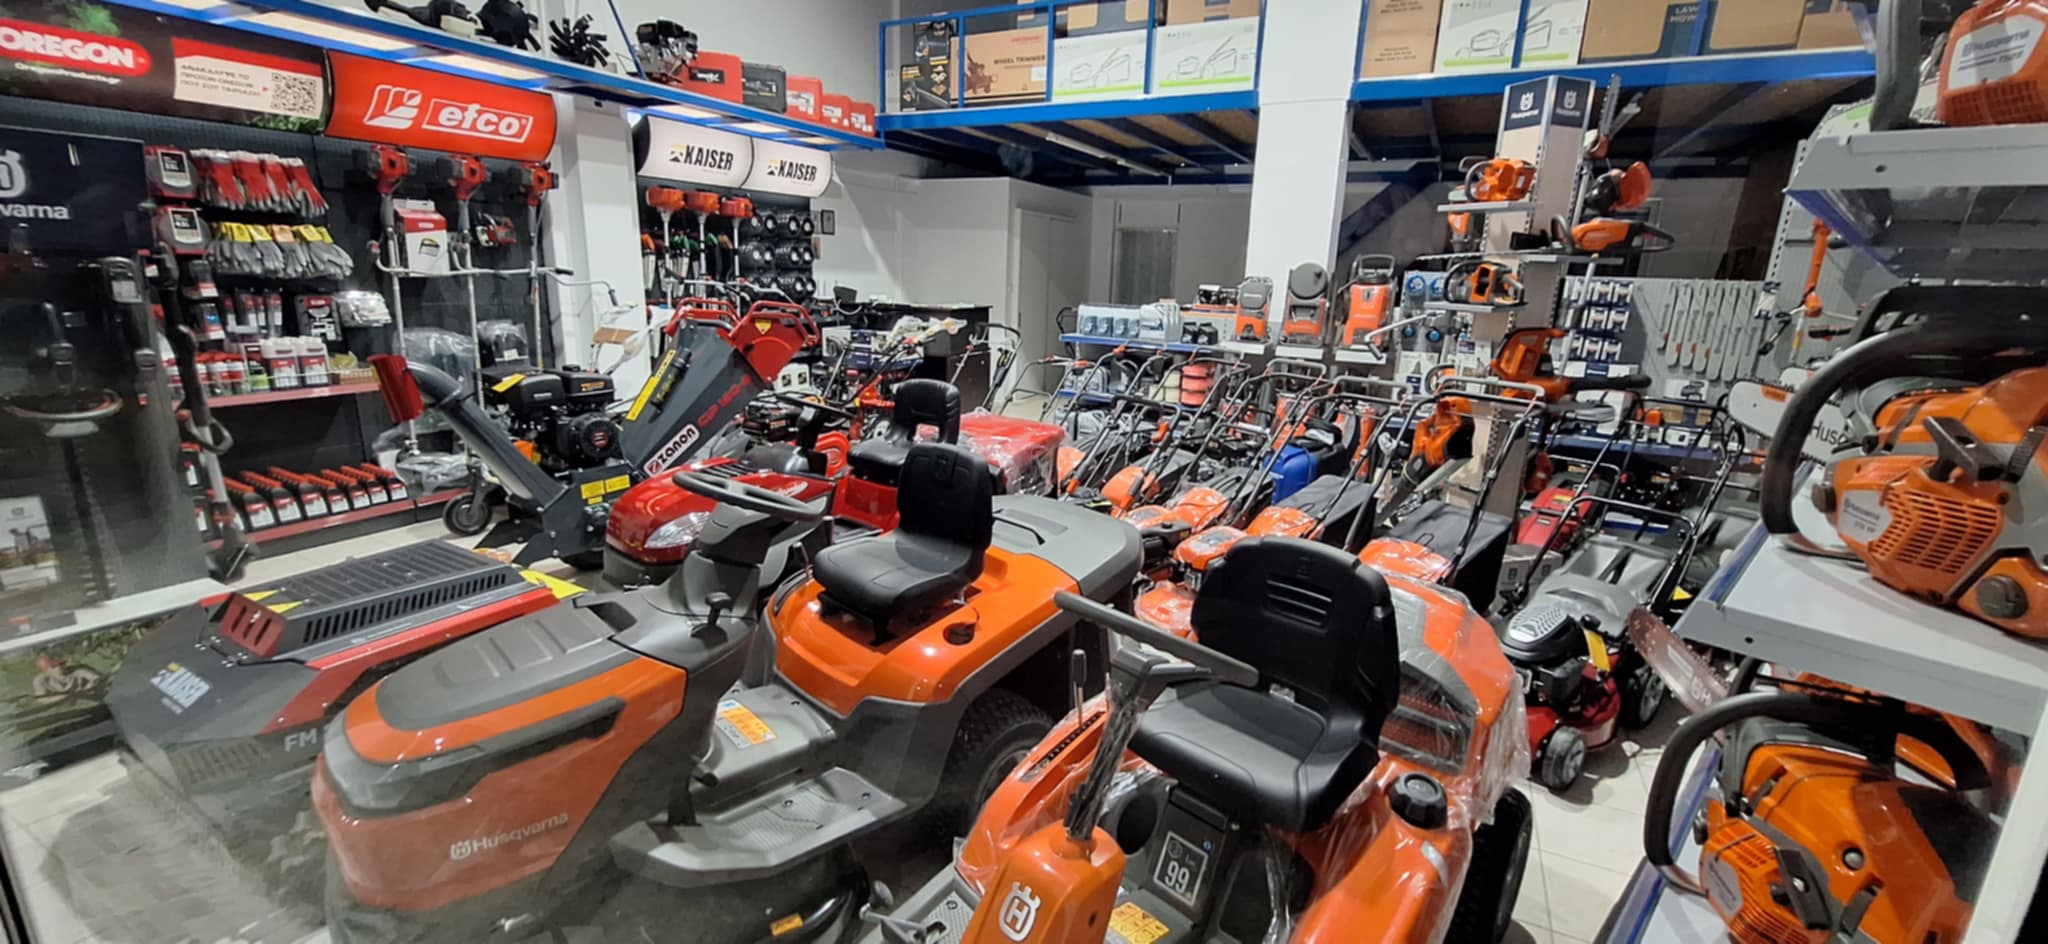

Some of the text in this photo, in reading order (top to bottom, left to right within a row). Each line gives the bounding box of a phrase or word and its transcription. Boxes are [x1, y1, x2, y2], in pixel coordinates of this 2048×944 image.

[0, 27, 135, 69] OREGON
[438, 103, 521, 137] efco
[683, 145, 734, 172] KAISER
[778, 159, 818, 182] KAISER
[0, 202, 70, 220] varna
[284, 728, 318, 752] FM
[472, 813, 569, 852] Husqvarna
[1164, 861, 1190, 894] 99
